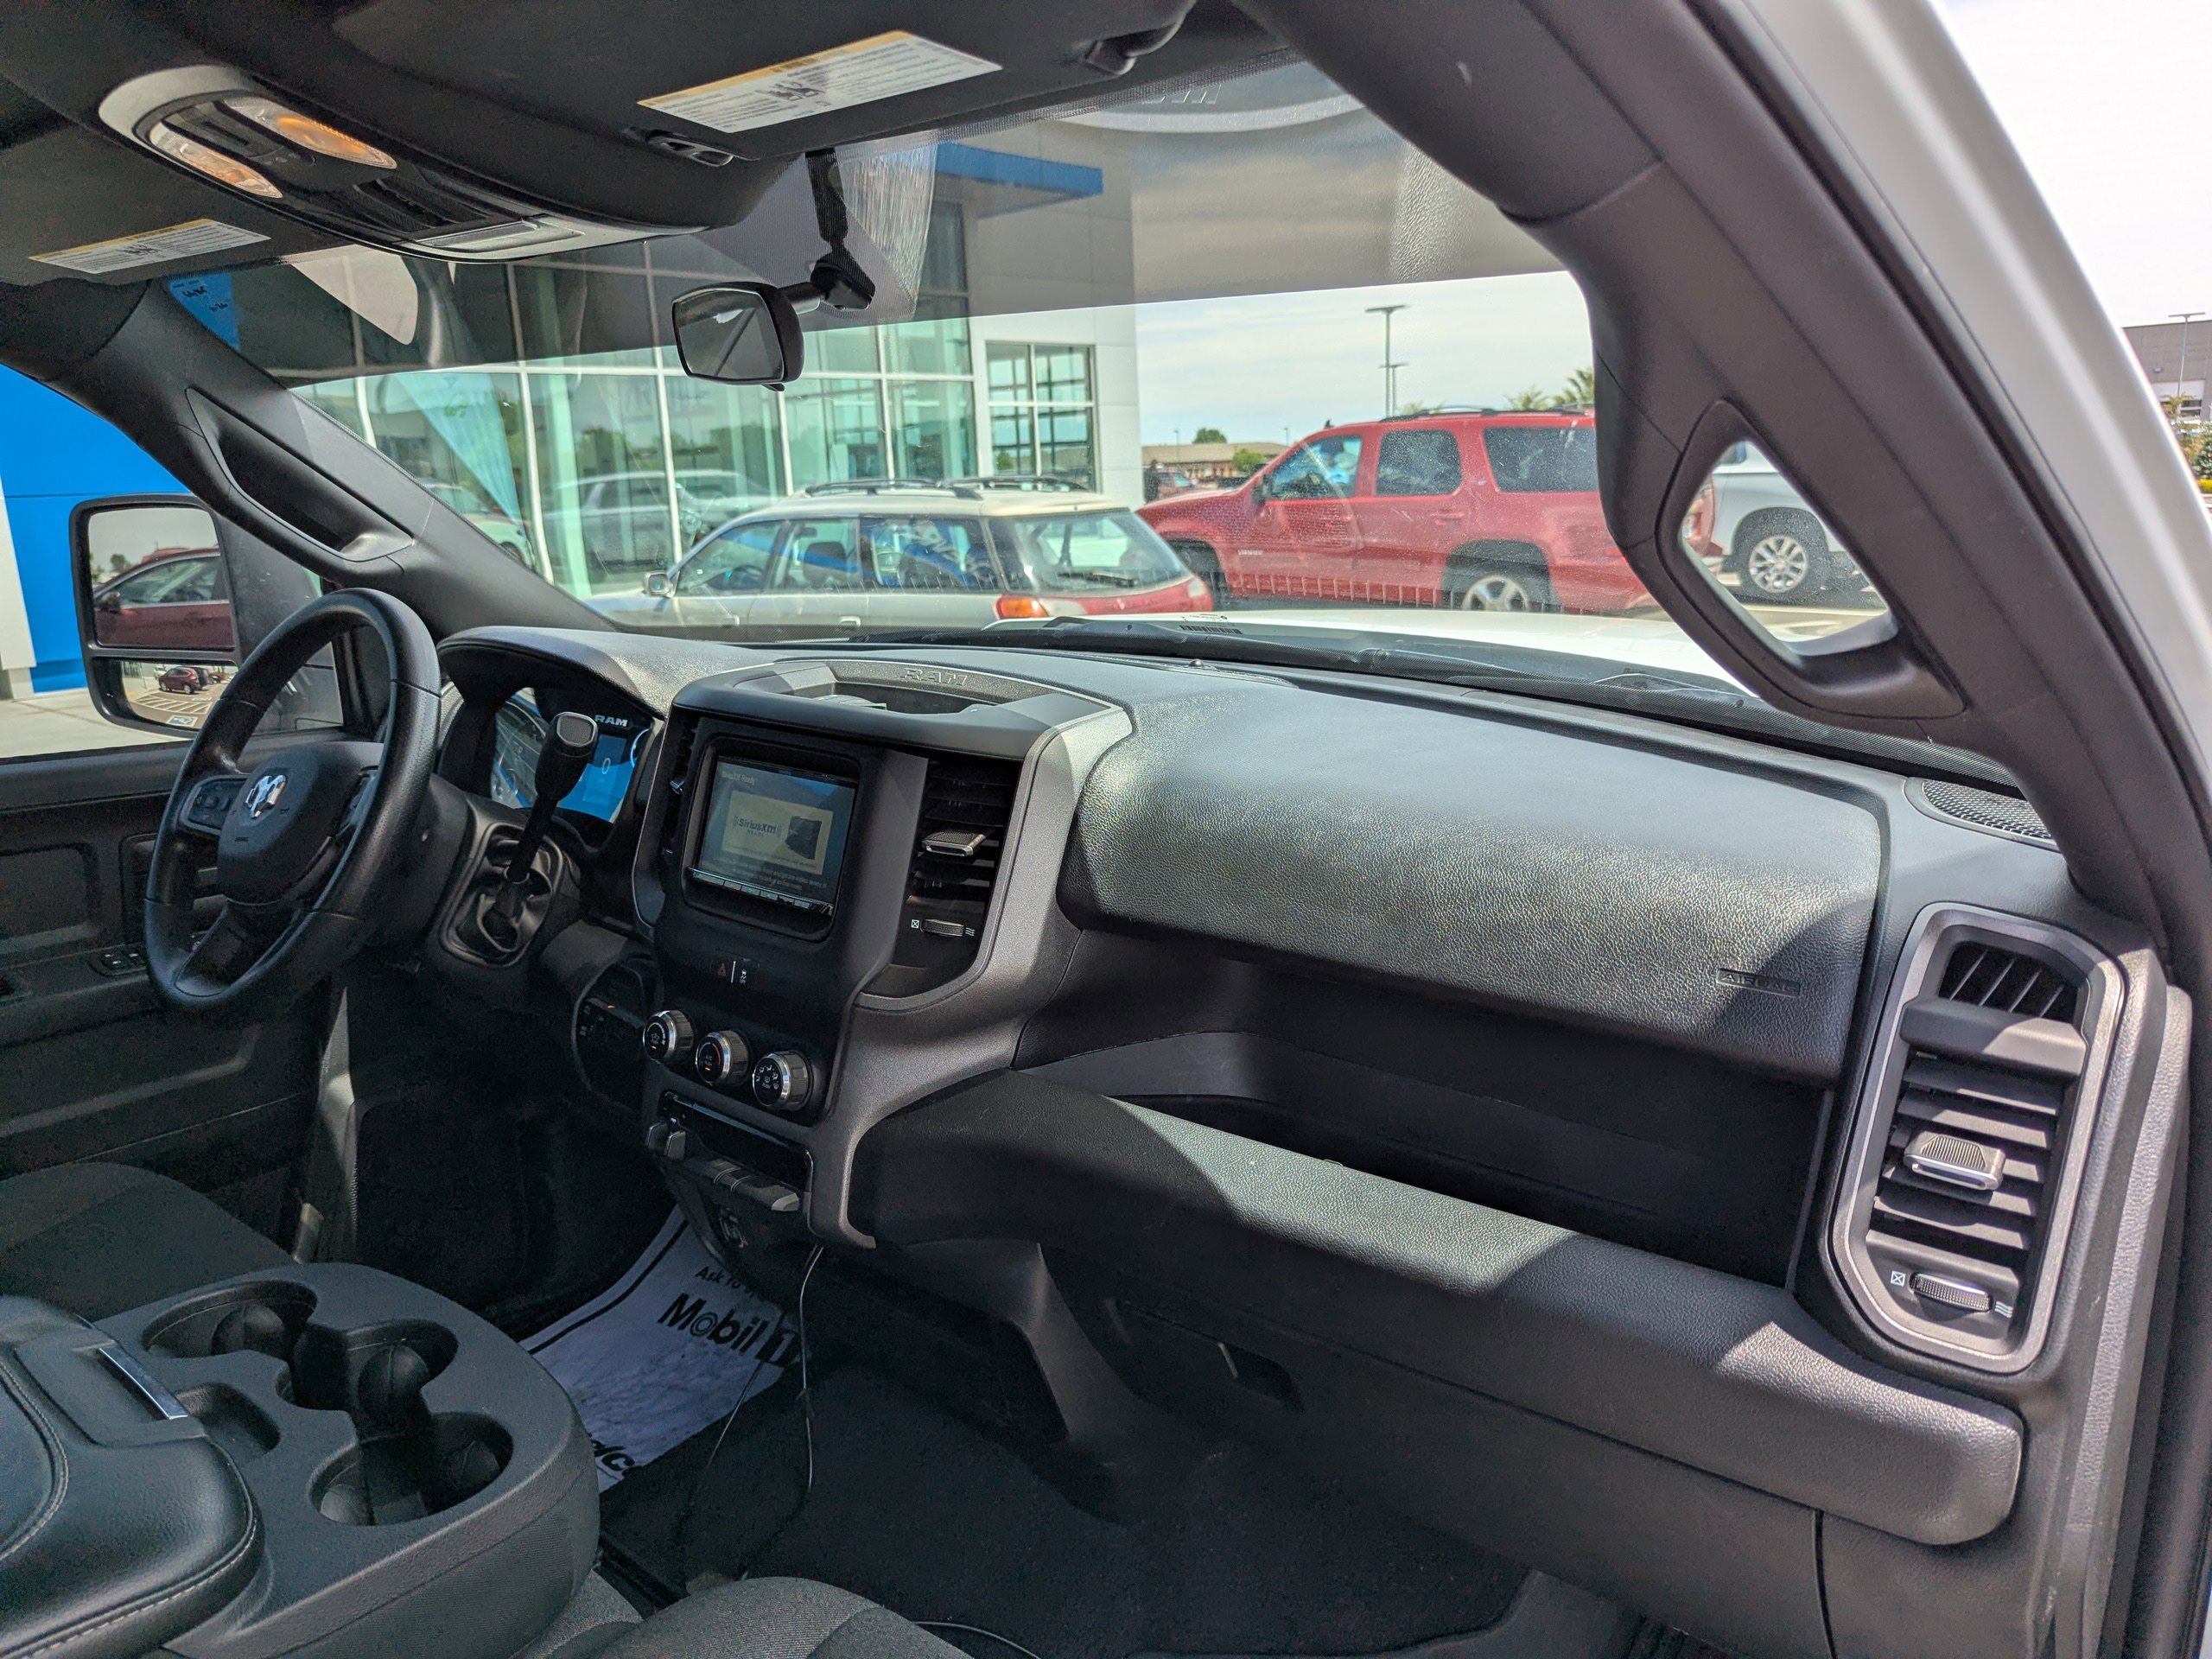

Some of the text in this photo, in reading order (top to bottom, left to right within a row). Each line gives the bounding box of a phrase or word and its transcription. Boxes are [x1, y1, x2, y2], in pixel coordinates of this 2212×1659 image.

[900, 668, 968, 686] RAM
[594, 715, 628, 727] RAM
[1720, 973, 1797, 993] AIRBAG
[696, 1266, 724, 1284] Ask
[657, 1293, 768, 1355] Mobil
